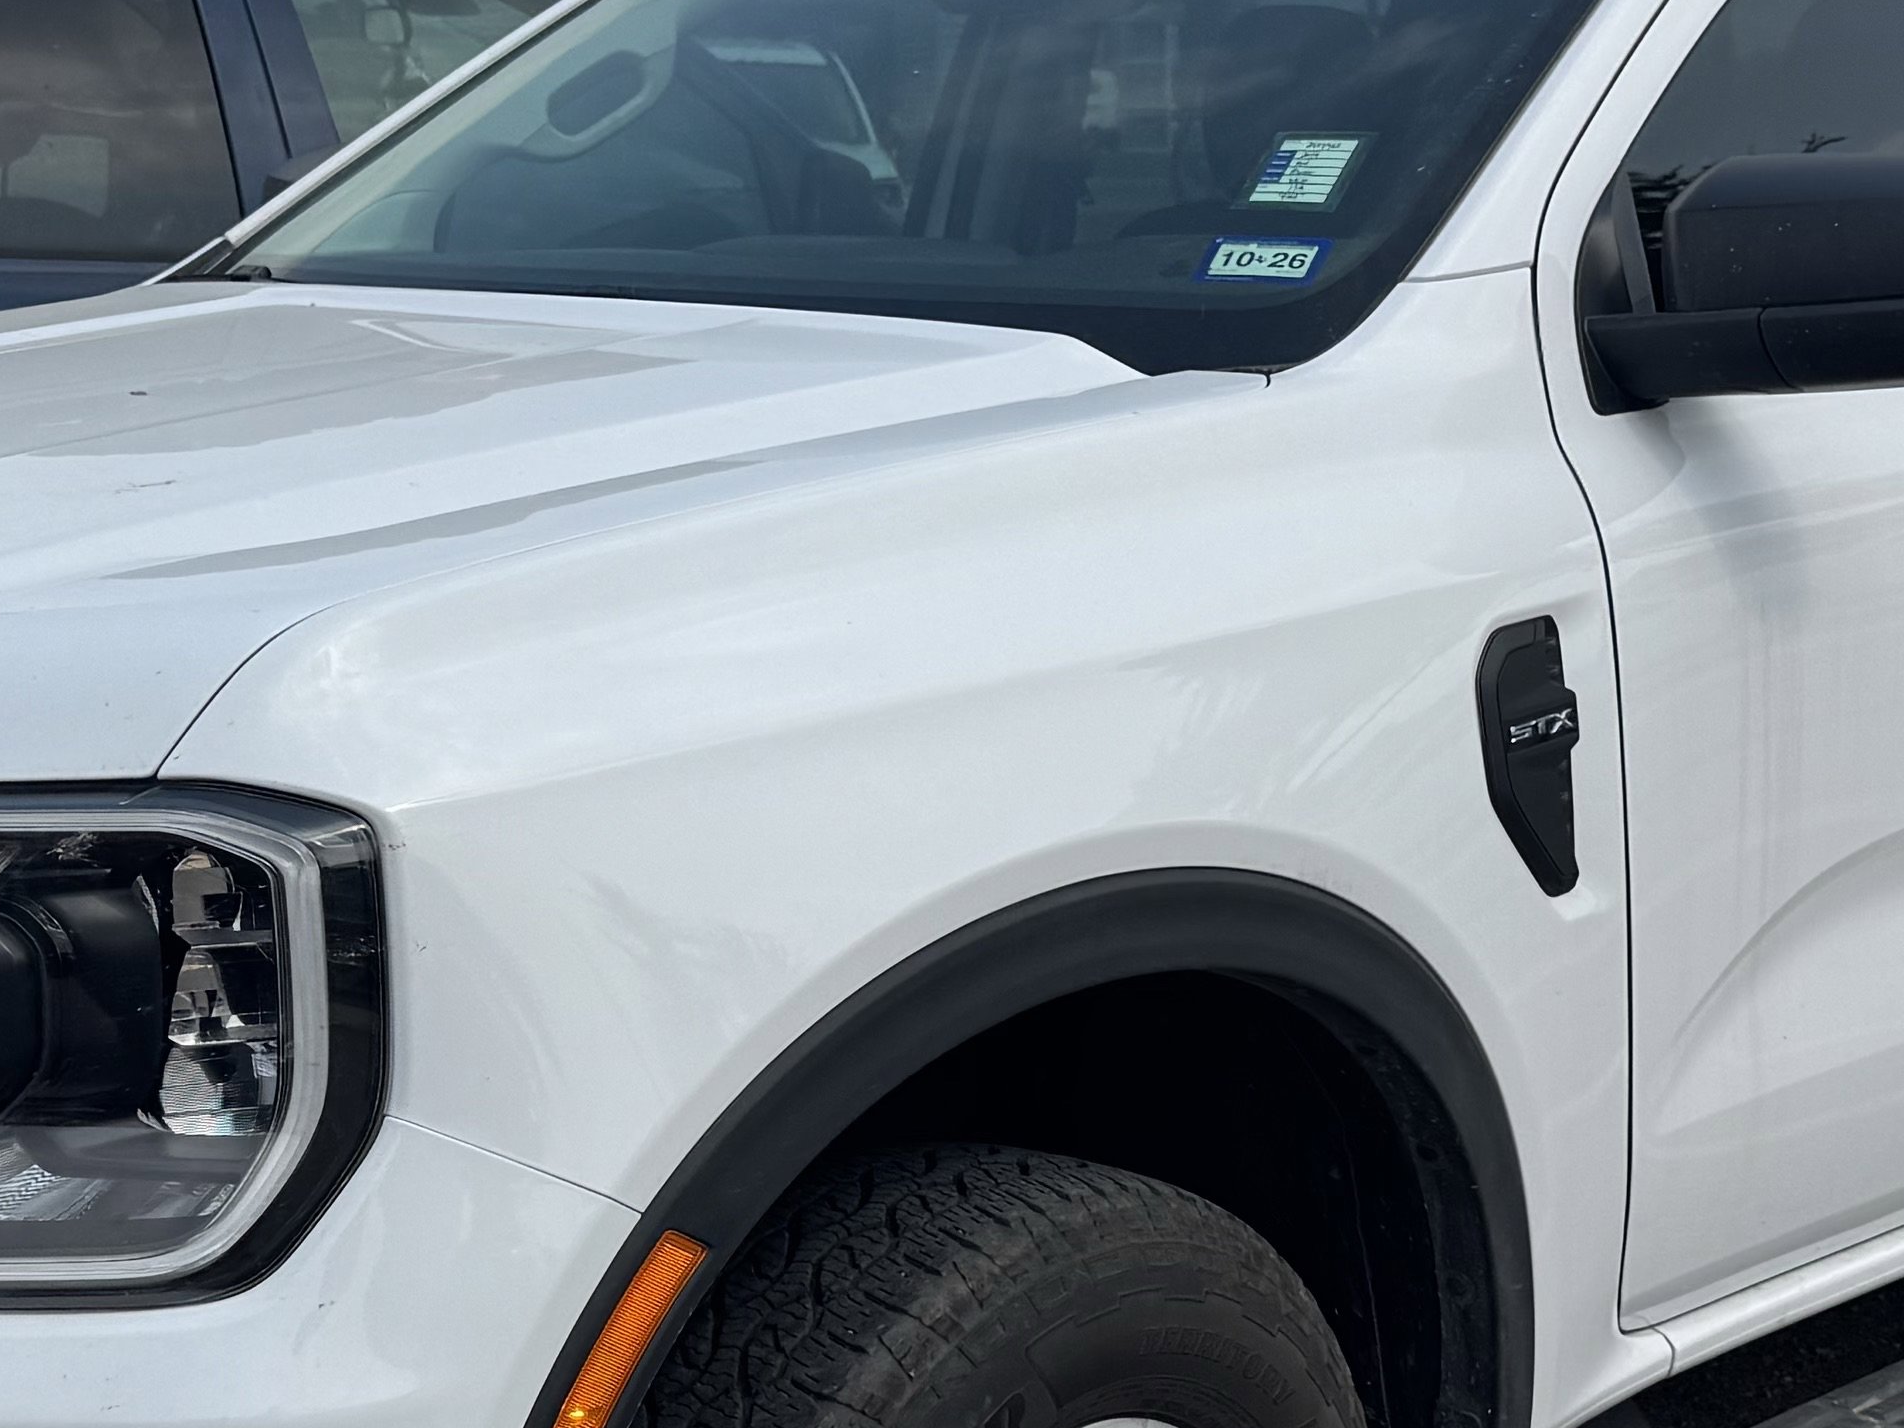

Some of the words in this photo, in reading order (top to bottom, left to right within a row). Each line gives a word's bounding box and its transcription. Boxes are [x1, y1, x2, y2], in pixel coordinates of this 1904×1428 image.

[1221, 250, 1256, 268] 10
[1266, 252, 1309, 270] 26
[1509, 708, 1575, 744] STX
